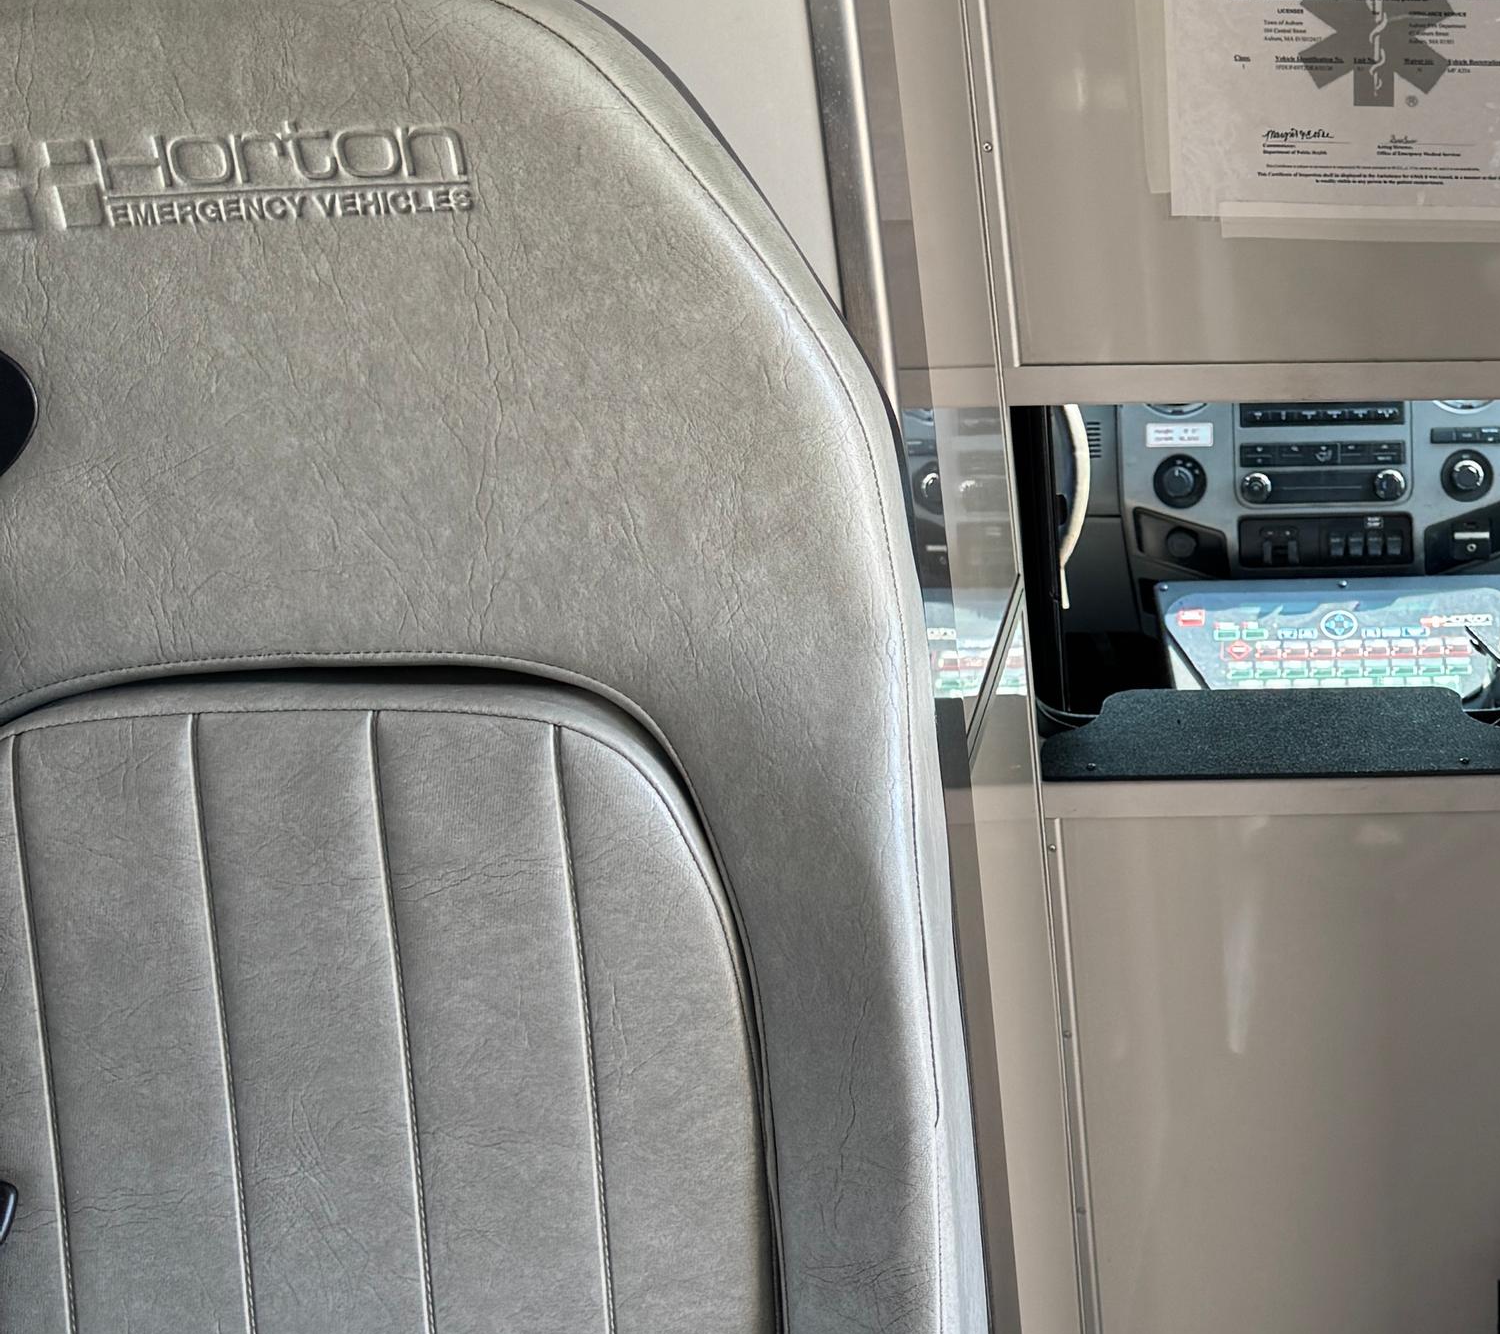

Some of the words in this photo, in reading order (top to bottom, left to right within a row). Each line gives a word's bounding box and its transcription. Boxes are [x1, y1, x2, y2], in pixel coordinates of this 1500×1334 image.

[89, 119, 467, 191] Horton
[104, 191, 305, 228] EMERGENCY
[313, 185, 475, 217] VEHICLES
